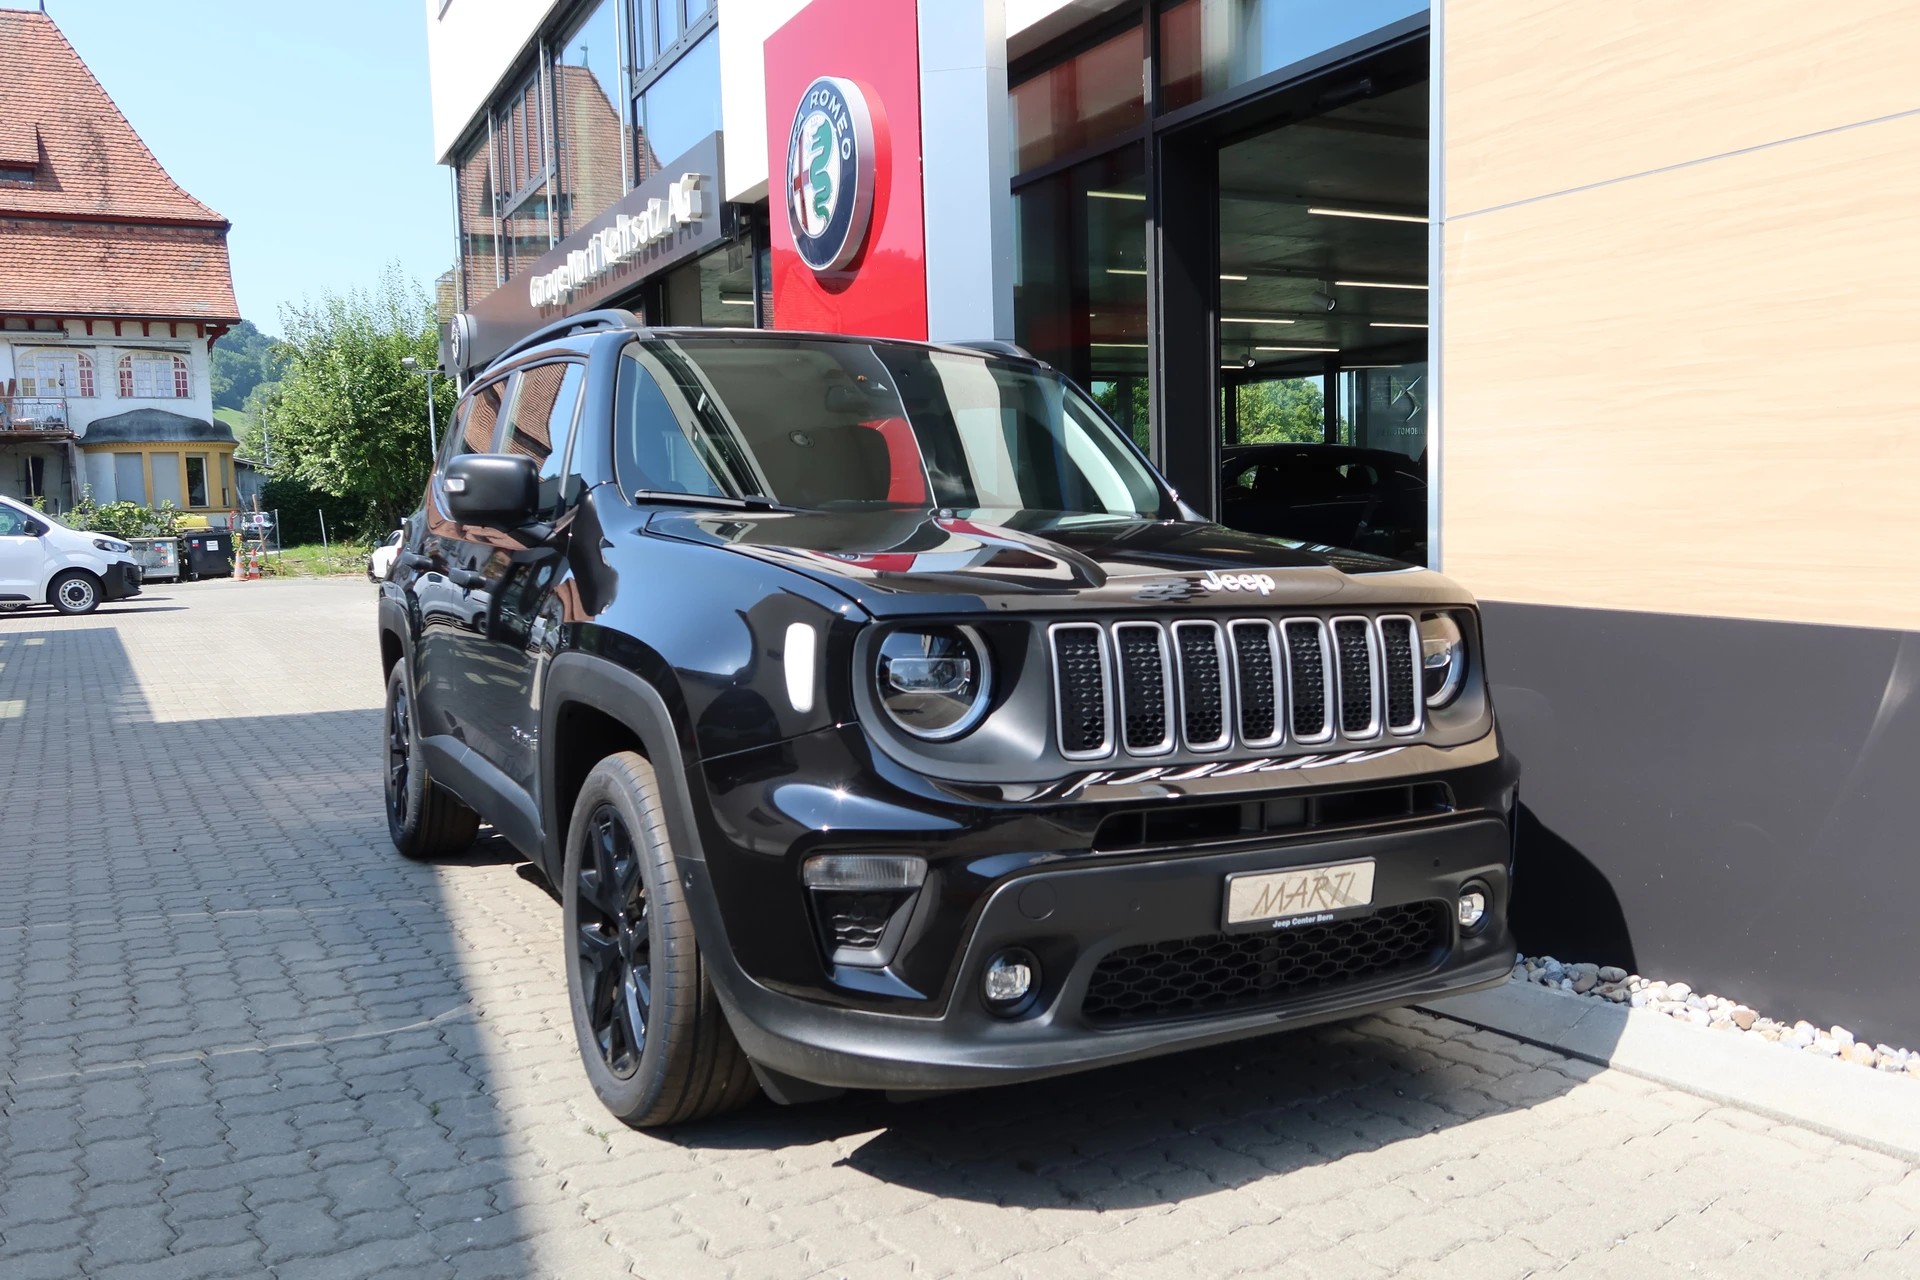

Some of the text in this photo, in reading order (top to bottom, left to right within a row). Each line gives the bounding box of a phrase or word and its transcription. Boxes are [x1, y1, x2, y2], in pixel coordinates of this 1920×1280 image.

[809, 89, 852, 161] ROMEO
[530, 265, 571, 308] Garage
[668, 173, 702, 228] AG
[1200, 570, 1276, 596] Jeep
[1251, 872, 1356, 916] MARTI
[1272, 913, 1334, 928] Jeep Center Bern
